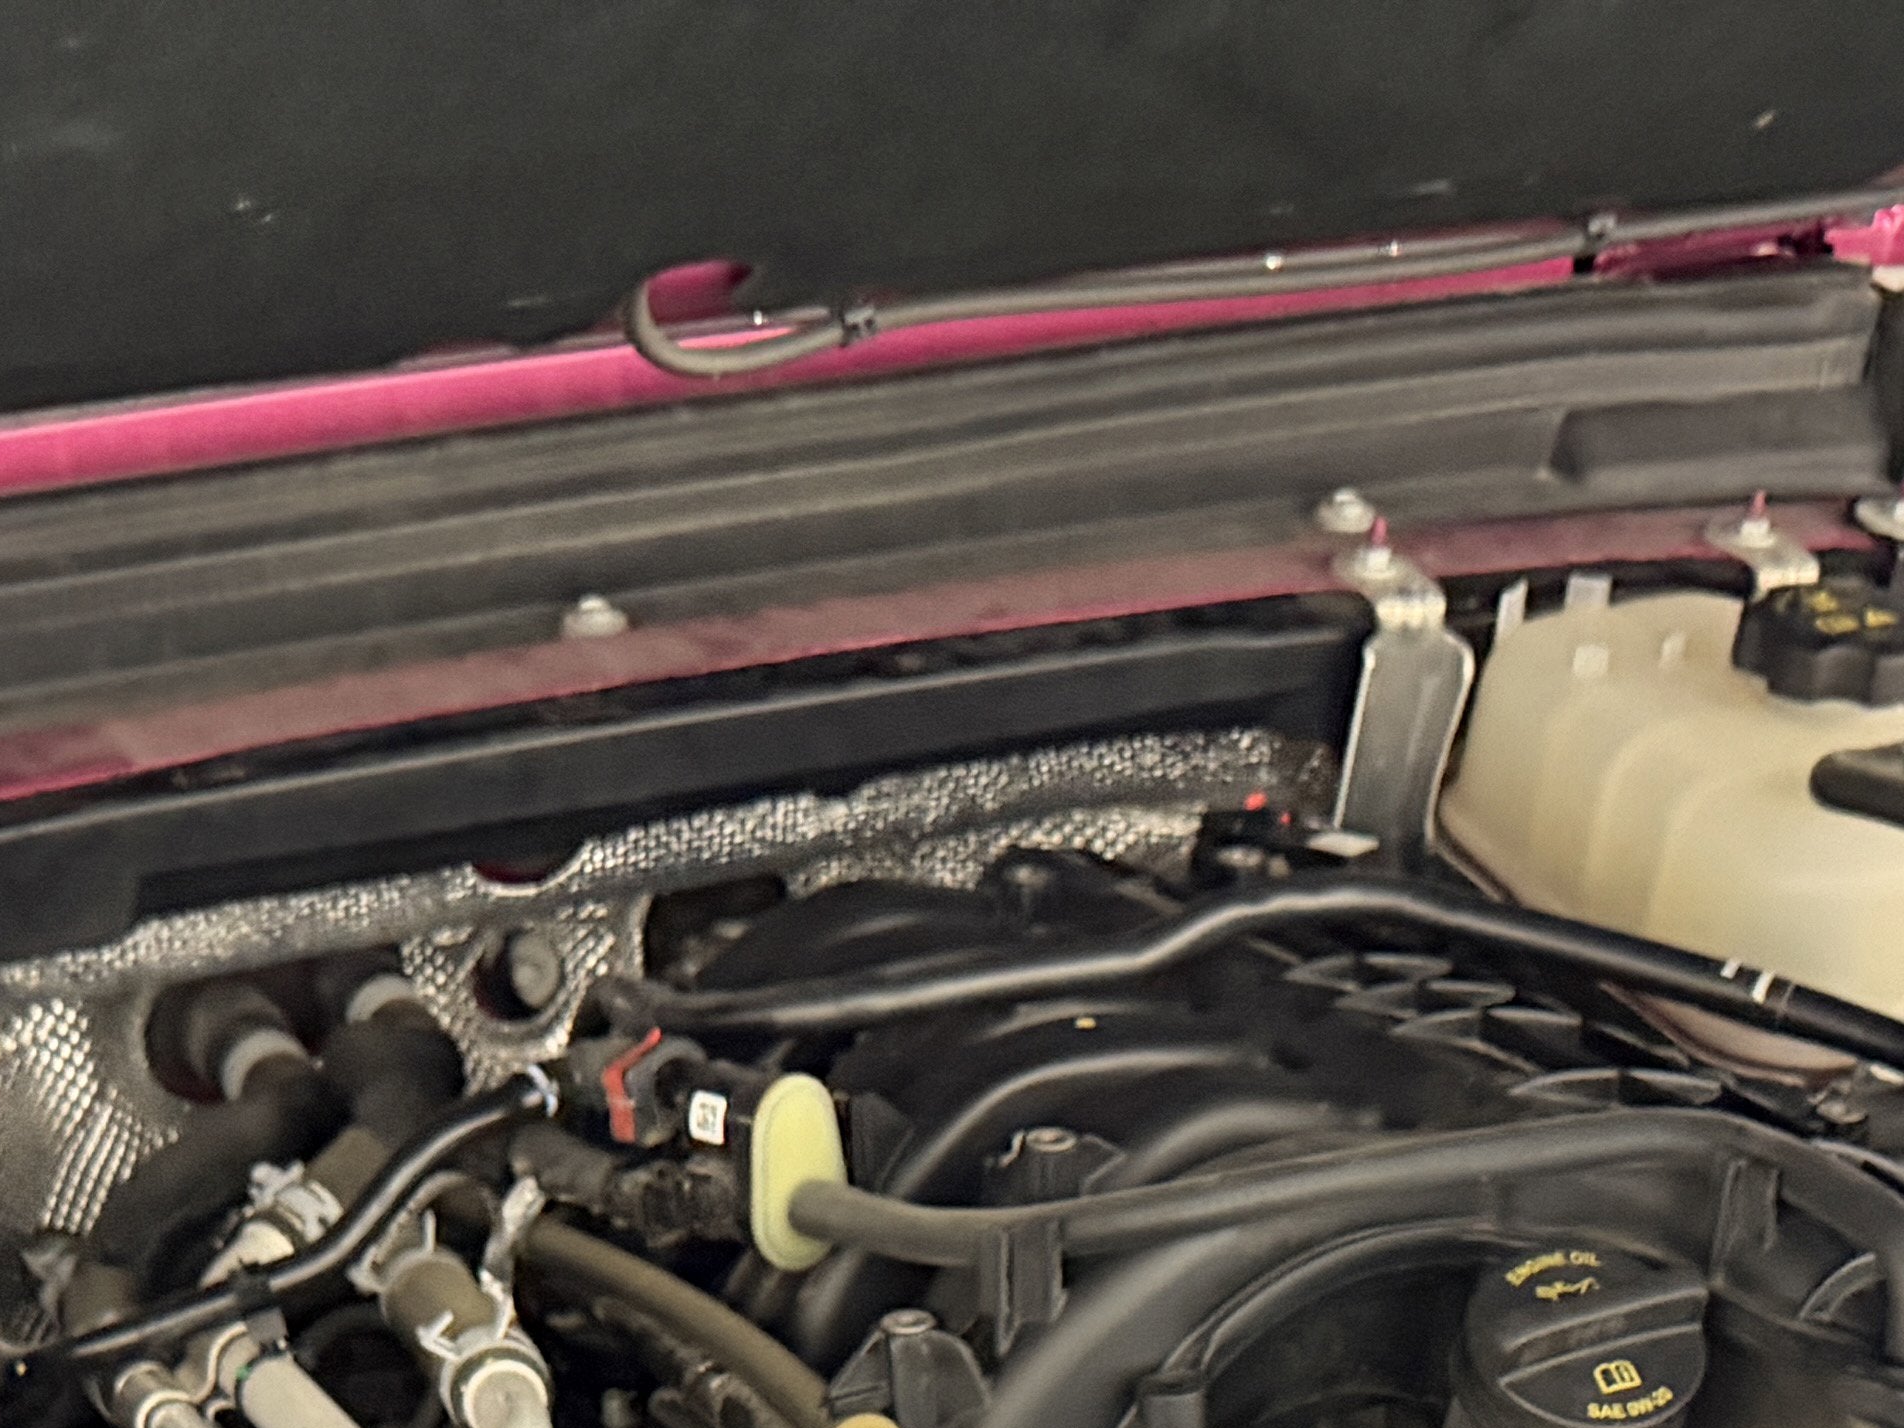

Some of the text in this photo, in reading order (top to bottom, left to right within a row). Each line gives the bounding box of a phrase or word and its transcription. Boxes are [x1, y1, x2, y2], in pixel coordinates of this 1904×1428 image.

[1504, 1250, 1602, 1287] ENGINE OIL
[1587, 1402, 1626, 1419] SAE
